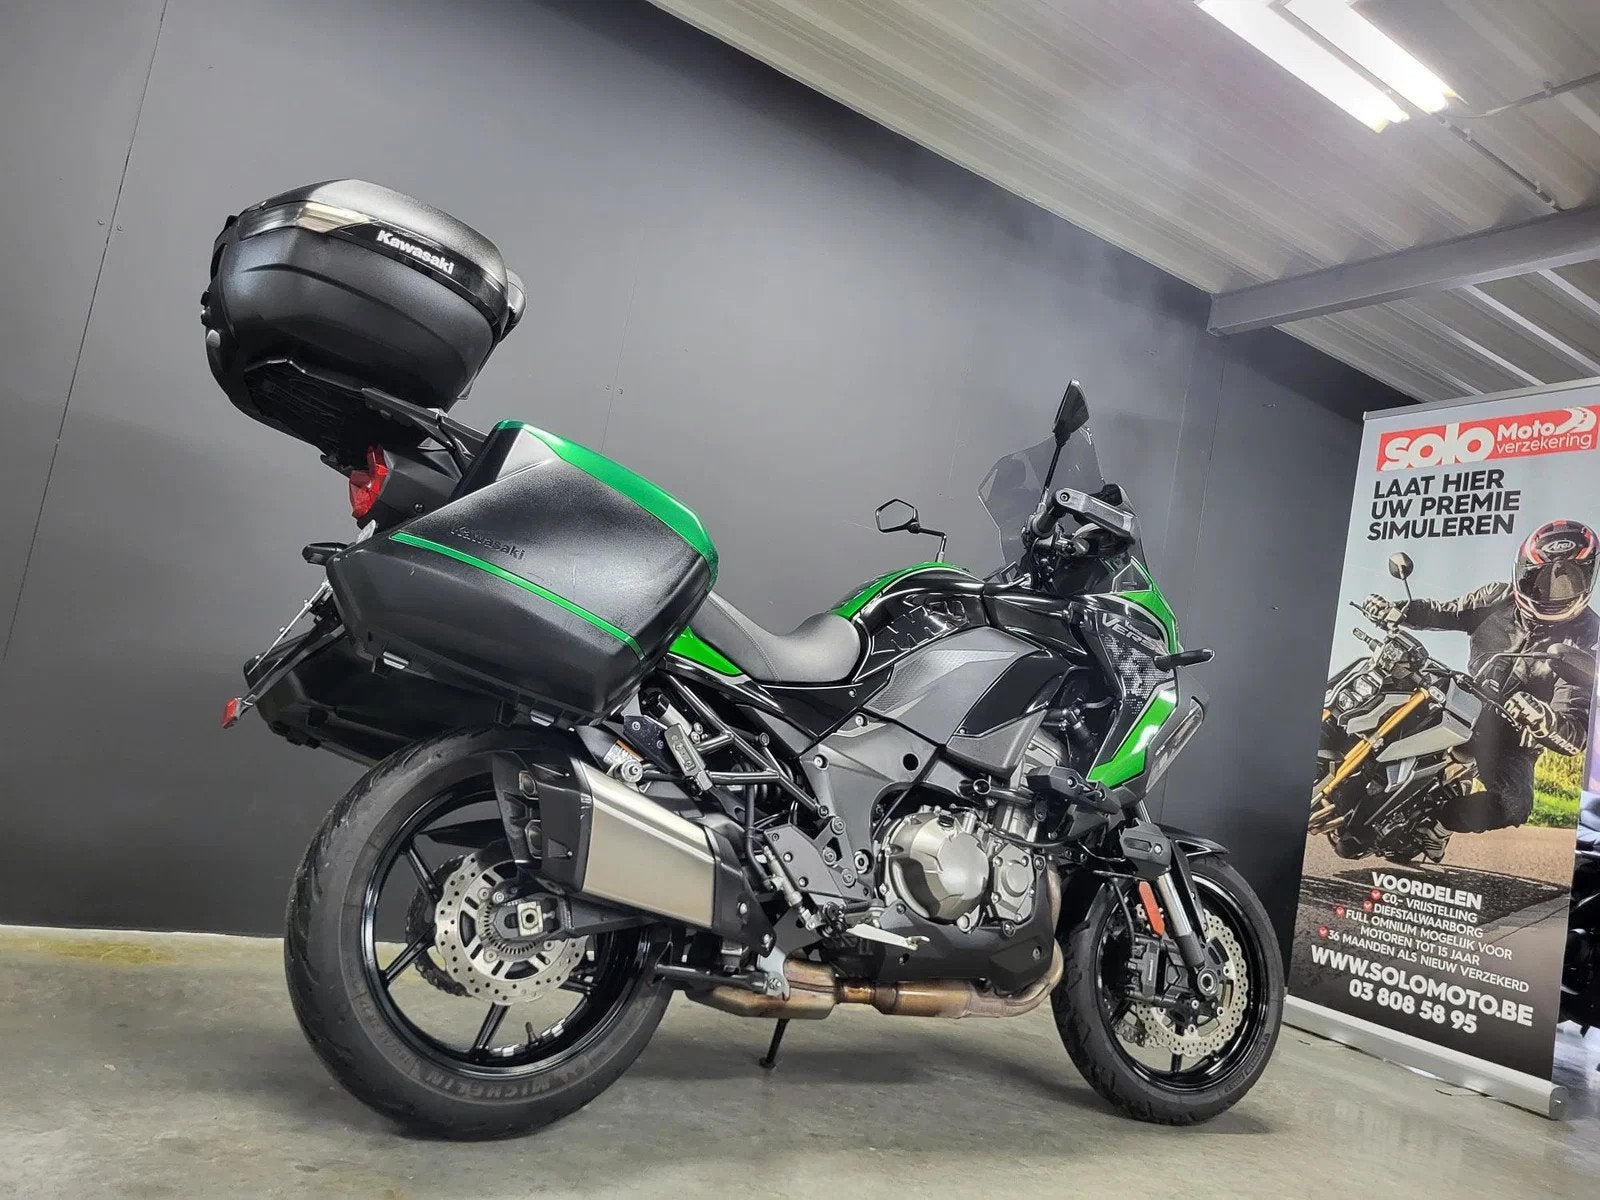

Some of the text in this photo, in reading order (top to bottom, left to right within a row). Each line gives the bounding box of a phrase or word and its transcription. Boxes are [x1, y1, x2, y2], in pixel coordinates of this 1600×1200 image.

[377, 230, 455, 275] Kawasaki
[1382, 423, 1495, 471] solo
[1496, 432, 1592, 454] verzekering
[1497, 420, 1556, 441] Moto
[1373, 469, 1504, 499] LAAT HIER
[1371, 490, 1521, 520] UW PREMIE
[1367, 514, 1515, 541] SIMULEREN
[1372, 872, 1482, 910] VOORDELEN
[1374, 904, 1484, 938] DIEFSTALWAARBORG
[1406, 898, 1478, 923] VRIJSTELLING
[1346, 910, 1512, 960] FULL OMNIUM MOGELIJK VOOR
[1360, 925, 1480, 966] MOTOREN TOT 15 JAAR
[1328, 929, 1529, 993] 36 MAANDEN ALS NIEUW VERZEKERD
[1311, 945, 1534, 1027] WWW.SOLOMOTO.BE
[1349, 979, 1477, 1034] 03 808 58 95
